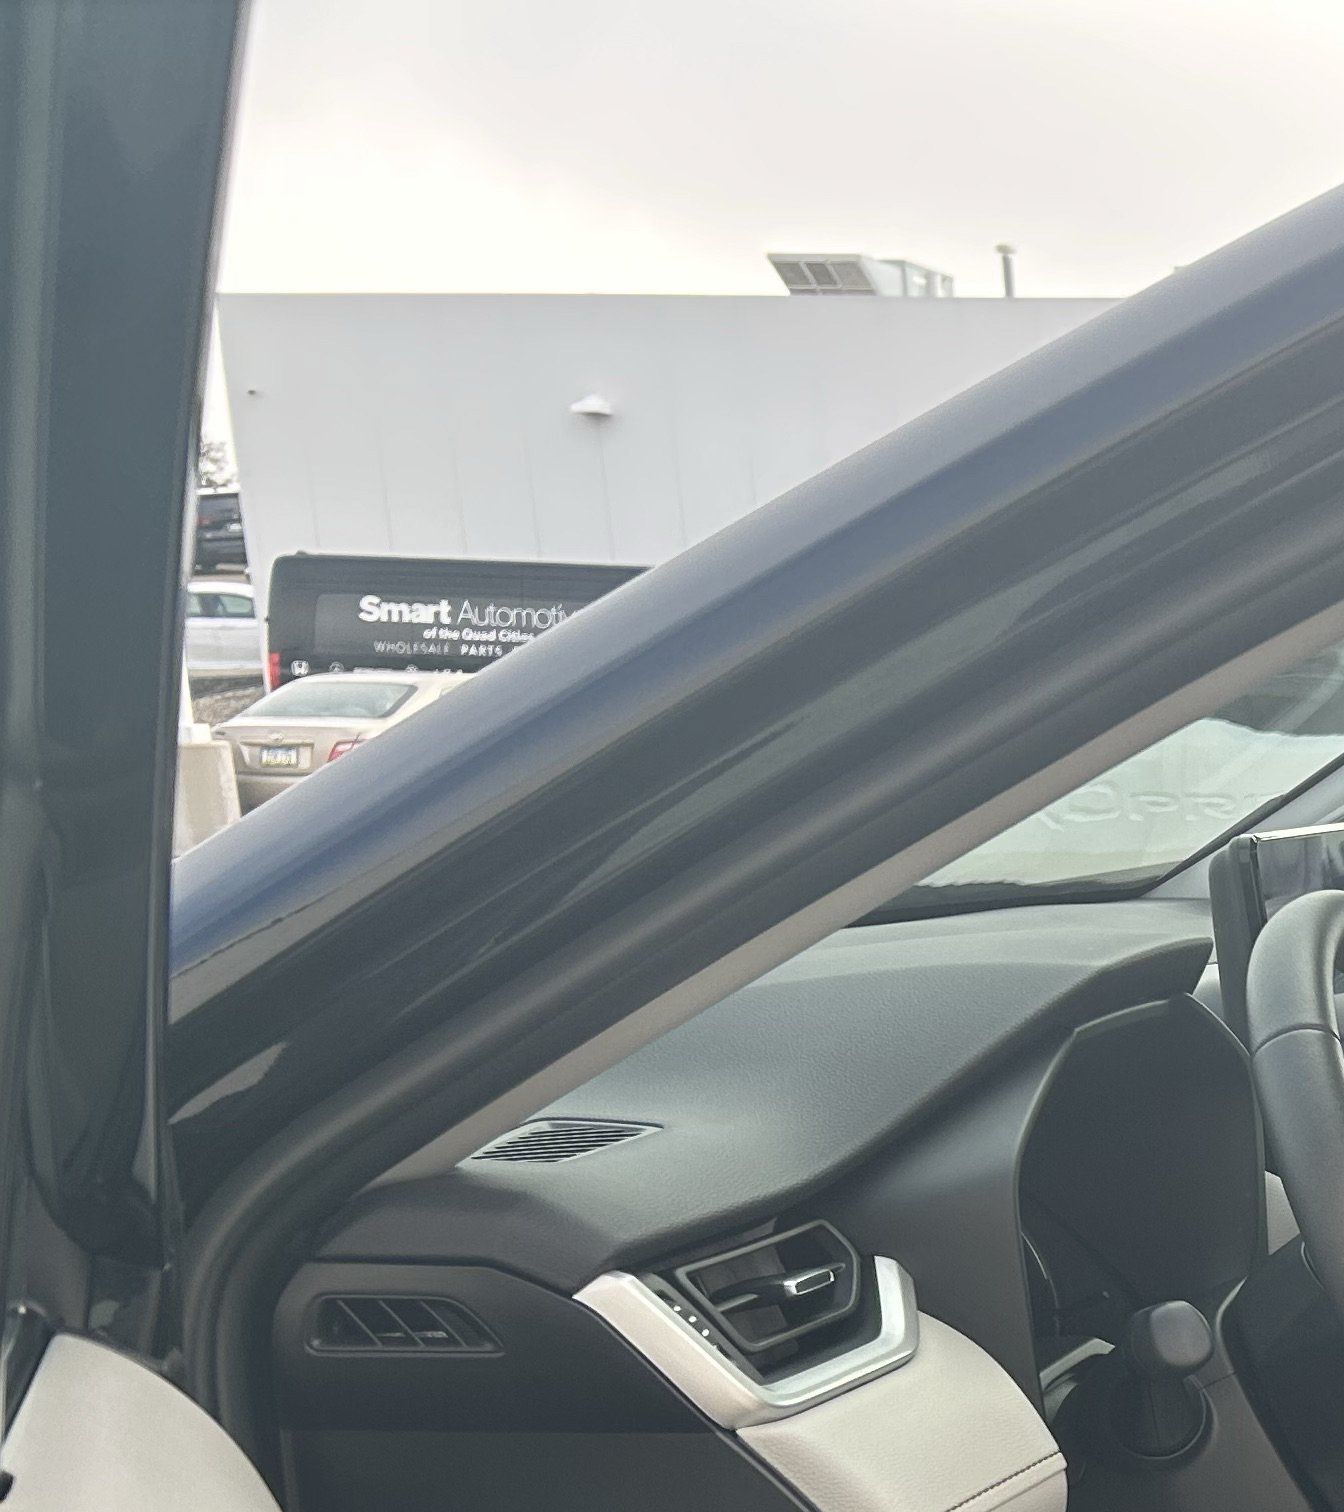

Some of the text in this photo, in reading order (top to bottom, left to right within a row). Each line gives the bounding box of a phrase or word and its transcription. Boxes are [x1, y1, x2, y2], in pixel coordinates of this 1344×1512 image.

[359, 594, 452, 625] Smart
[423, 626, 536, 643] of the Quad Cities
[373, 641, 450, 656] WHOLESALE
[461, 643, 503, 657] PARTS
